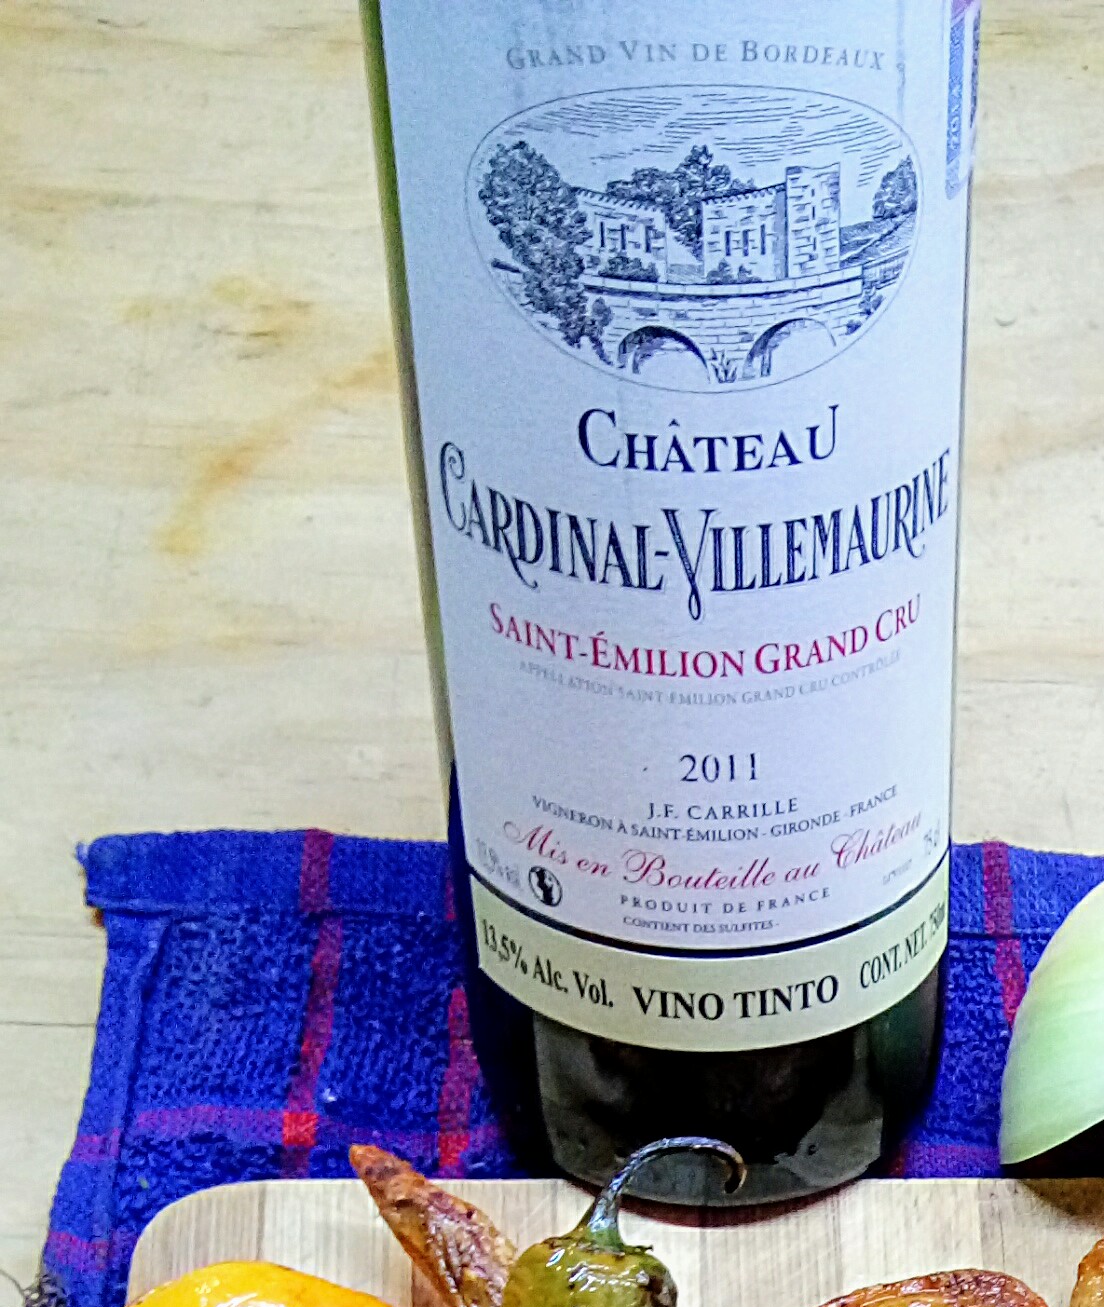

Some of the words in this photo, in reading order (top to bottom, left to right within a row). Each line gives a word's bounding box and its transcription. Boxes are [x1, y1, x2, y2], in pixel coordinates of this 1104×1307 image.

[506, 45, 606, 70] GRAND
[619, 40, 677, 62] VIN
[692, 43, 728, 62] DE
[741, 40, 885, 71] BORDEAUX
[577, 404, 839, 473] CHÂTEAU
[439, 441, 951, 621] CARDINAL-VILLEMAURINE
[489, 602, 744, 678] SAINT-ÉMILION
[754, 625, 868, 675] GRAND
[875, 593, 920, 642] CRU
[742, 684, 796, 704] GRAND
[799, 677, 829, 696] CRU
[679, 752, 759, 783] 2011
[532, 795, 613, 830] VIGNERON
[770, 809, 840, 838] GIRONDE
[849, 784, 898, 818] FRANCE
[647, 802, 679, 820] J.F.
[687, 797, 799, 820] CARRILLE
[503, 821, 568, 866] Mis
[577, 856, 612, 876] en
[621, 848, 777, 891] Bouteille
[784, 862, 820, 883] au
[830, 810, 922, 870] Château
[620, 894, 713, 914] PRODUIT
[722, 901, 757, 914] DE
[757, 887, 831, 914] FRANCE
[623, 915, 689, 934] CONTIENT
[693, 923, 716, 934] DES
[533, 955, 568, 994] Alc.
[572, 970, 614, 1008] Vol.
[632, 985, 723, 1021] VINO
[734, 974, 839, 1019] TINTO
[860, 944, 902, 989] CONT.
